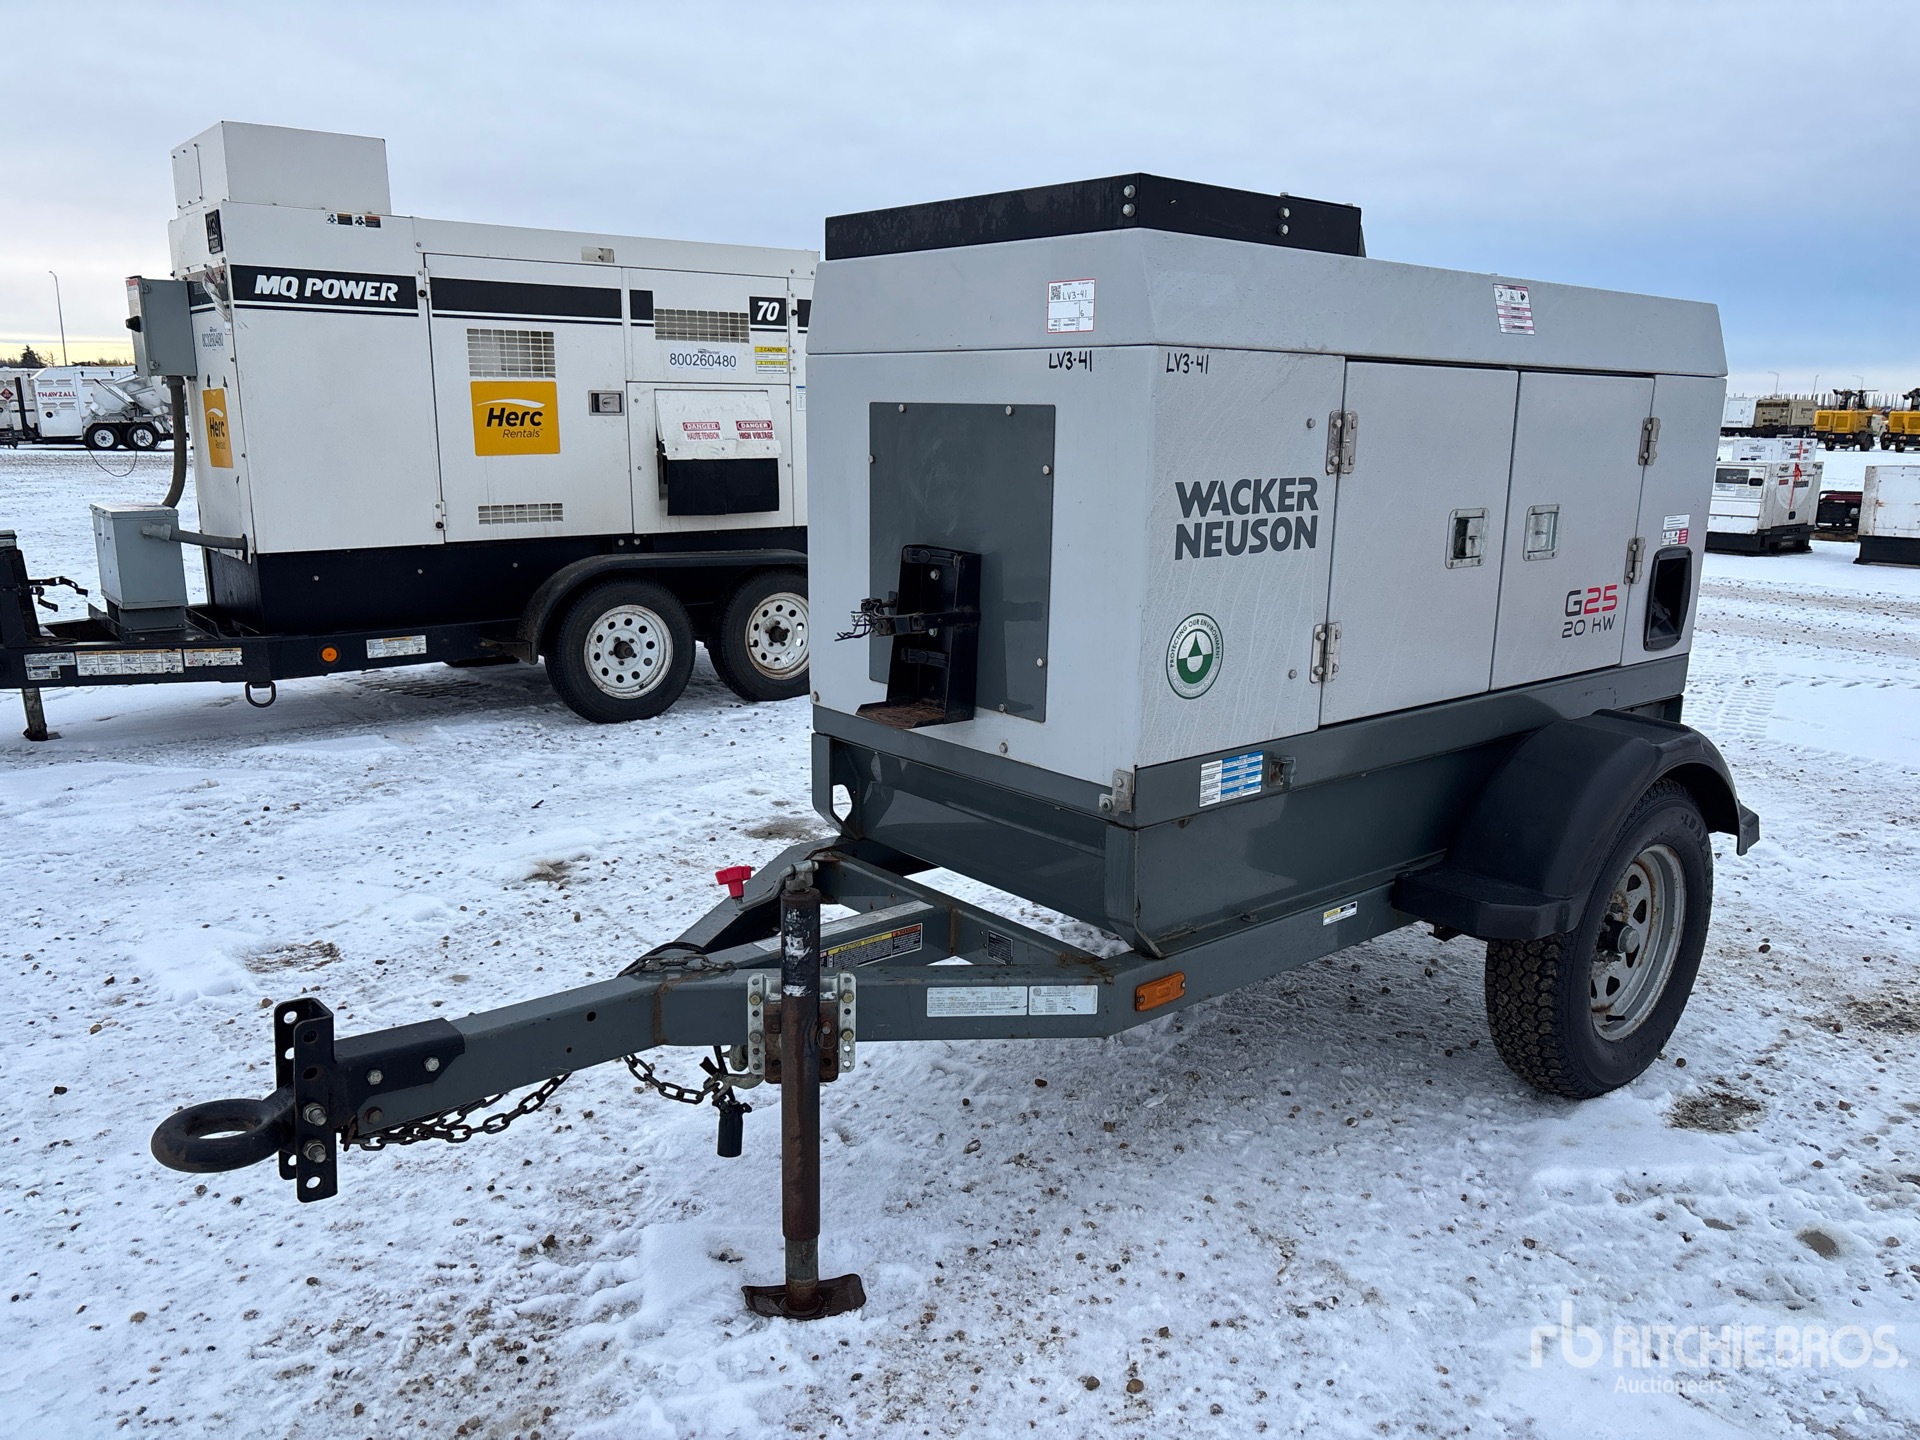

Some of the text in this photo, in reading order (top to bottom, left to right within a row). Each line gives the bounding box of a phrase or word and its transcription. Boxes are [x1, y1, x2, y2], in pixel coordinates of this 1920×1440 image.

[254, 274, 399, 302] MQ POWER
[756, 301, 780, 321] 70
[669, 352, 737, 368] 800260480
[486, 407, 544, 427] Herc
[687, 422, 716, 430] DANGER
[741, 421, 768, 429] DANGER
[209, 417, 225, 438] Herc
[687, 432, 720, 440] HAUTE TENSION
[739, 432, 774, 440] HIGH VOLTAGE
[1175, 477, 1319, 518] WACKER
[1174, 515, 1318, 560] NEUSON
[1565, 584, 1618, 617] G25
[1561, 619, 1586, 638] 20
[1169, 618, 1220, 668] PROTECTING OUR ENVIRONMENT
